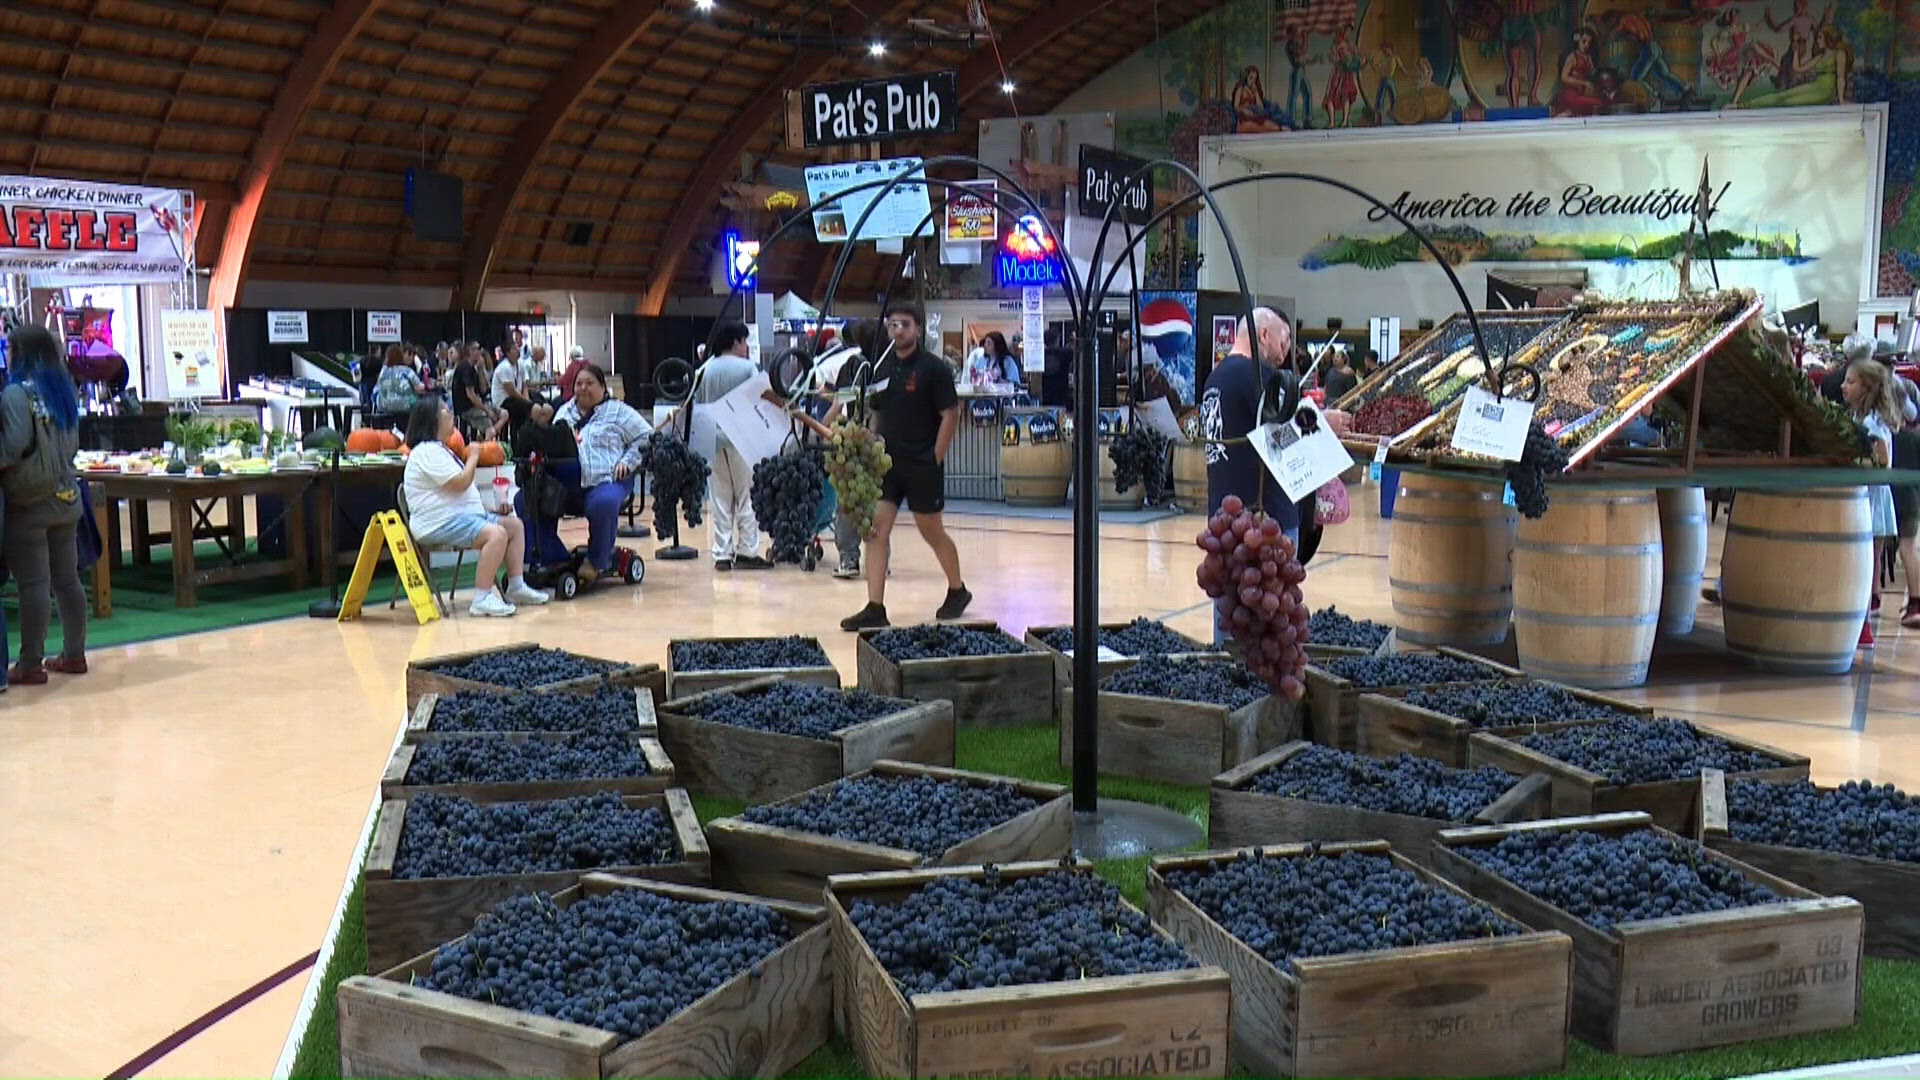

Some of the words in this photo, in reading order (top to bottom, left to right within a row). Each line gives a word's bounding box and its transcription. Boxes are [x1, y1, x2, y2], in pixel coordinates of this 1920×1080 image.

[814, 87, 878, 140] Pat's
[887, 80, 940, 132] Pub
[807, 170, 830, 180] Pat's
[832, 168, 849, 178] Pub
[1085, 166, 1119, 202] Pat's
[35, 186, 95, 202] CHICKEN
[98, 191, 144, 206] DINNER
[1367, 190, 1499, 221] America
[1506, 190, 1550, 218] the
[1031, 421, 1055, 433] Modelo
[1633, 979, 1712, 1009] LINDEN
[1721, 959, 1849, 999] ASSOCIATED
[1702, 993, 1800, 1027] GROWERS
[1048, 1044, 1212, 1079] ASSOCIATED
